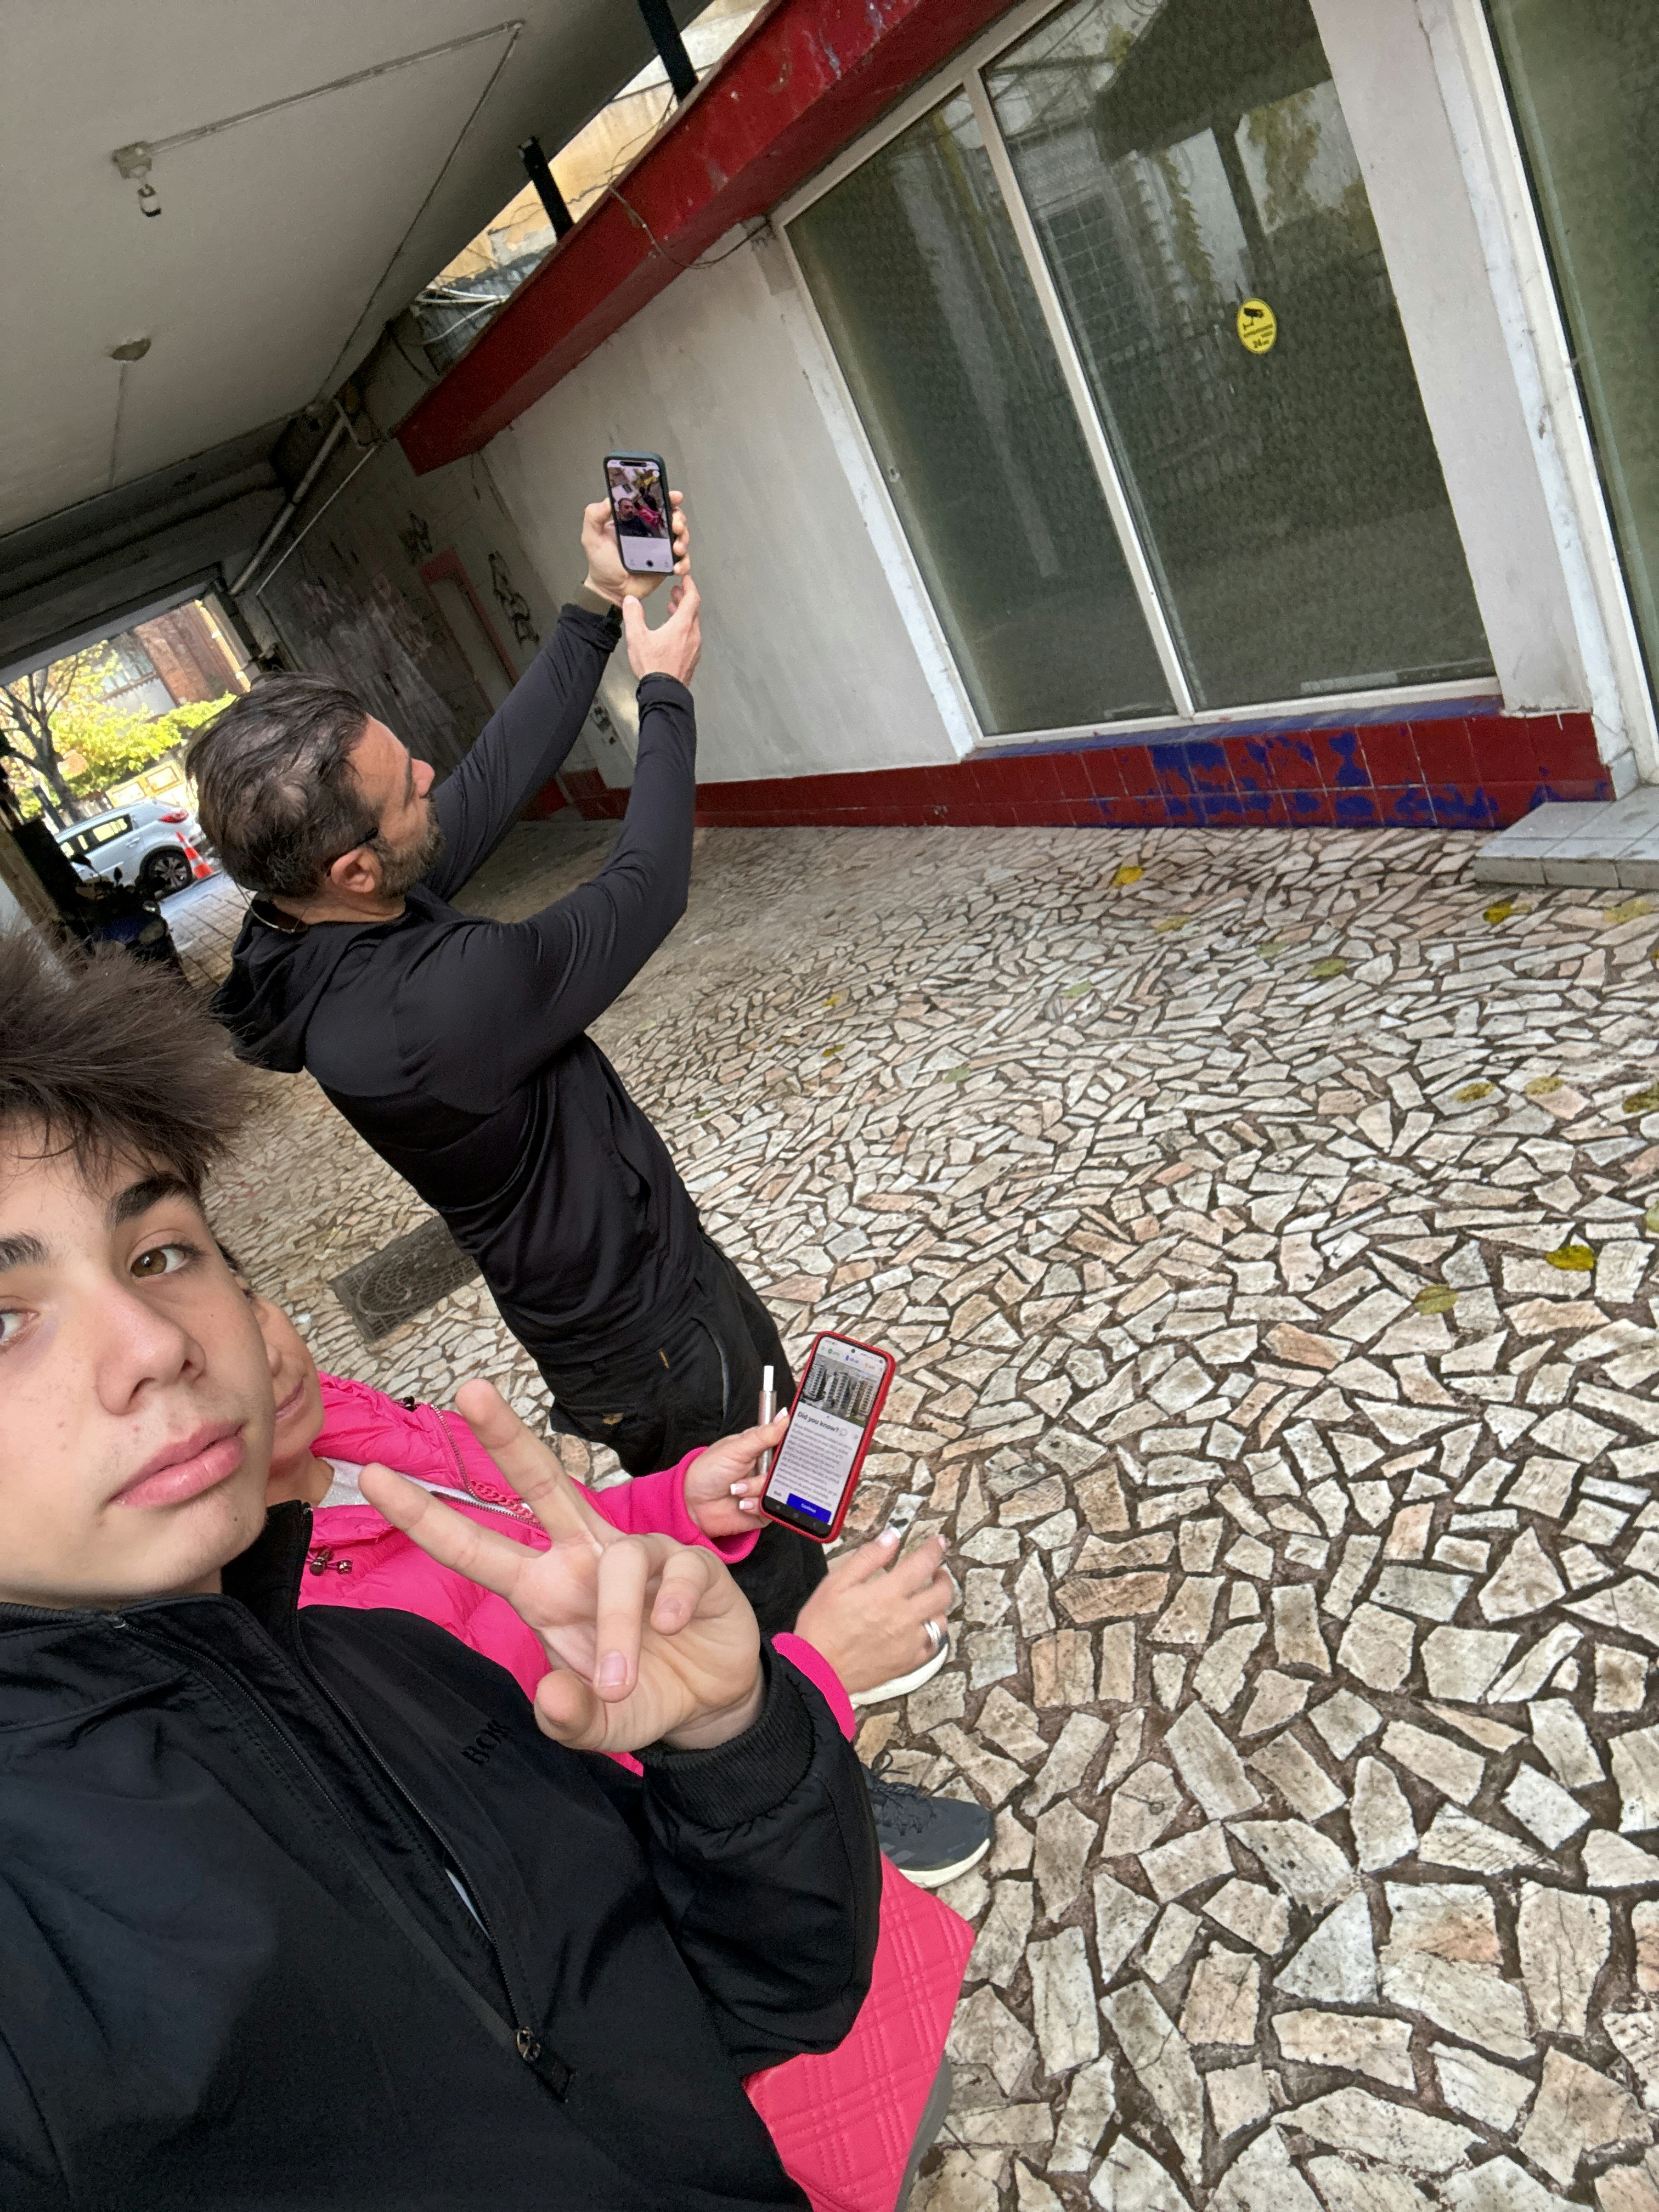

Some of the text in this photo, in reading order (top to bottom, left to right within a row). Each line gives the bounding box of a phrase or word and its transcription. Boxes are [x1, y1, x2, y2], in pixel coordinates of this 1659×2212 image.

[797, 1412, 839, 1433] Did you know?
